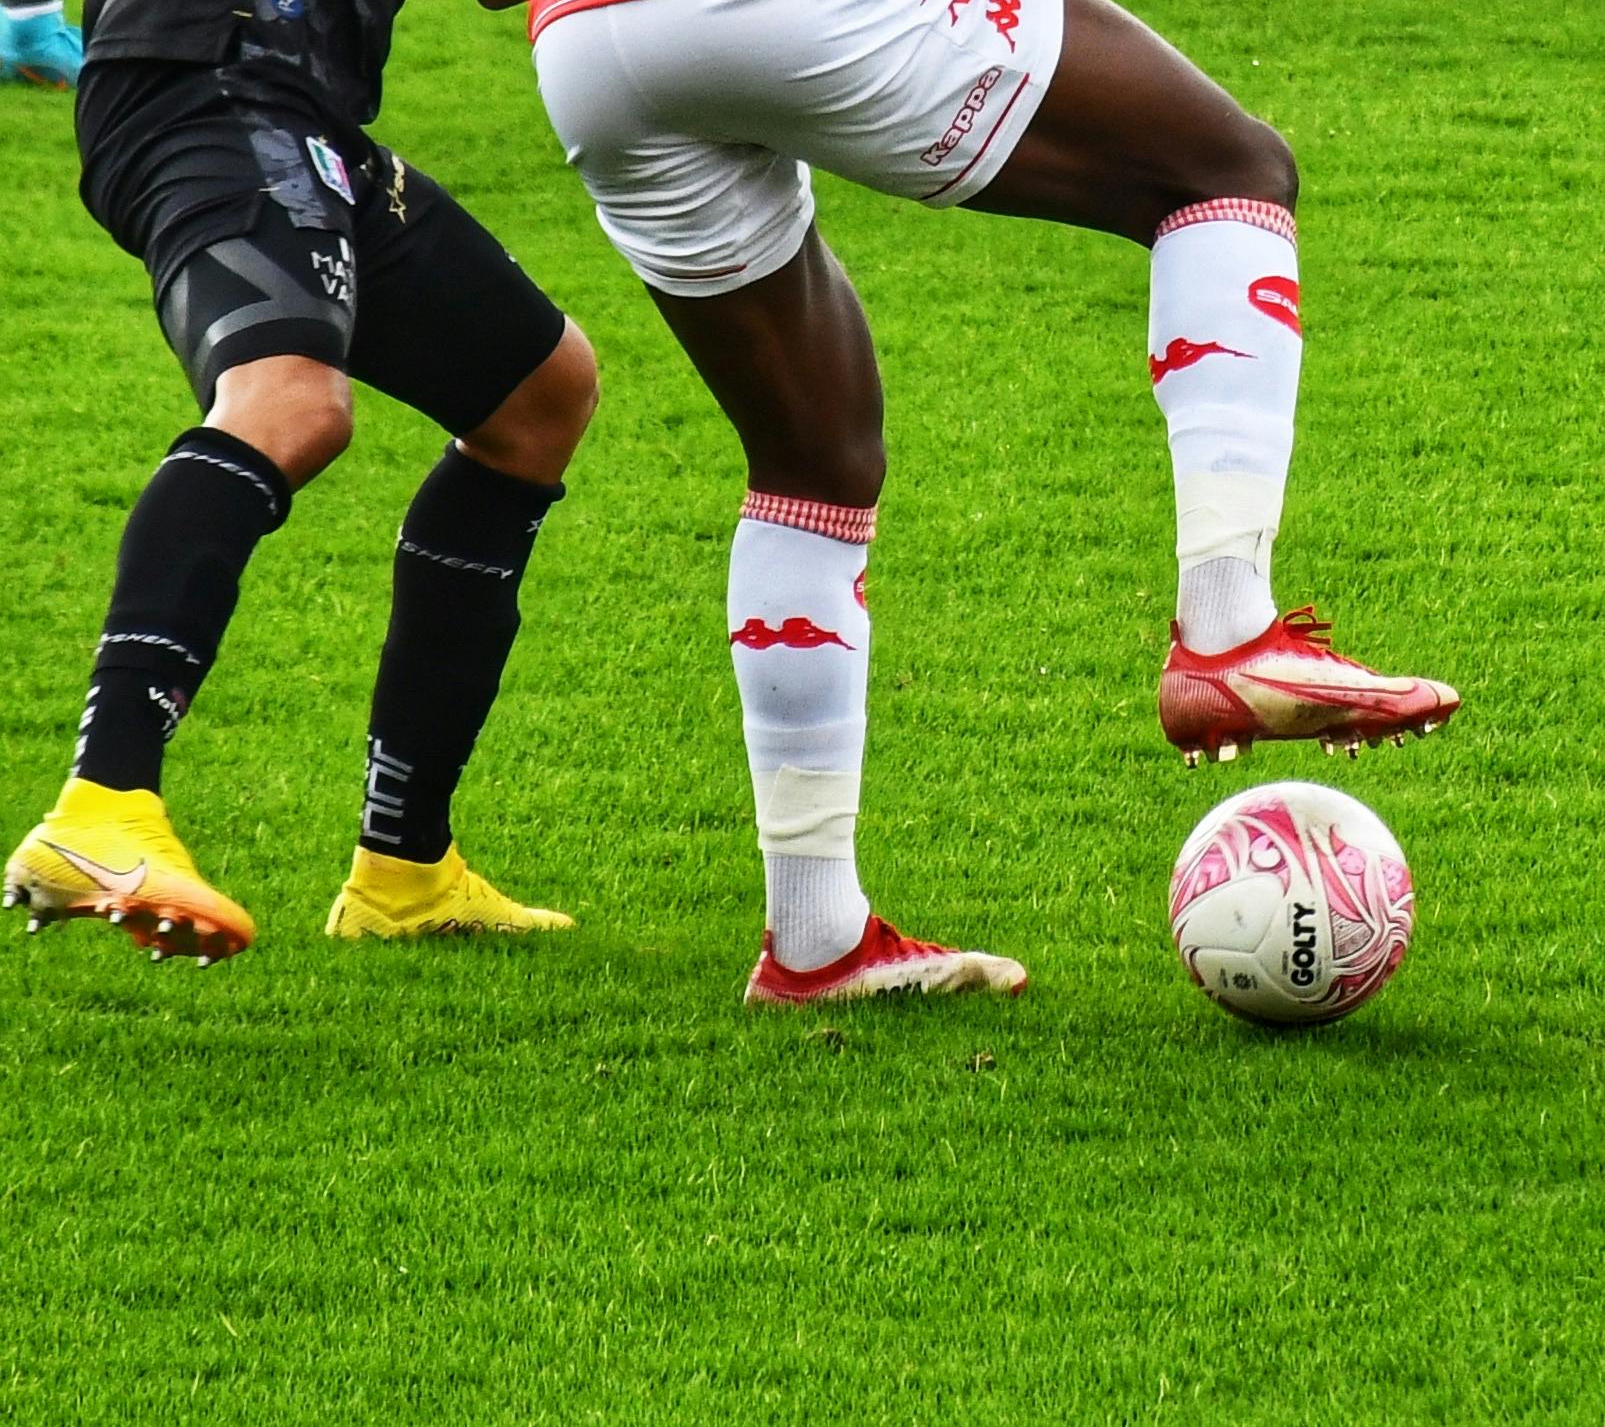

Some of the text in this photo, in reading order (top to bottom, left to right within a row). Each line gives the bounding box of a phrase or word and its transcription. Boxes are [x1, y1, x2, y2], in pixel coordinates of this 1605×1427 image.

[920, 65, 1004, 166] Kappa
[401, 541, 514, 580] SHEFFY
[1290, 902, 1316, 987] GOLTY
